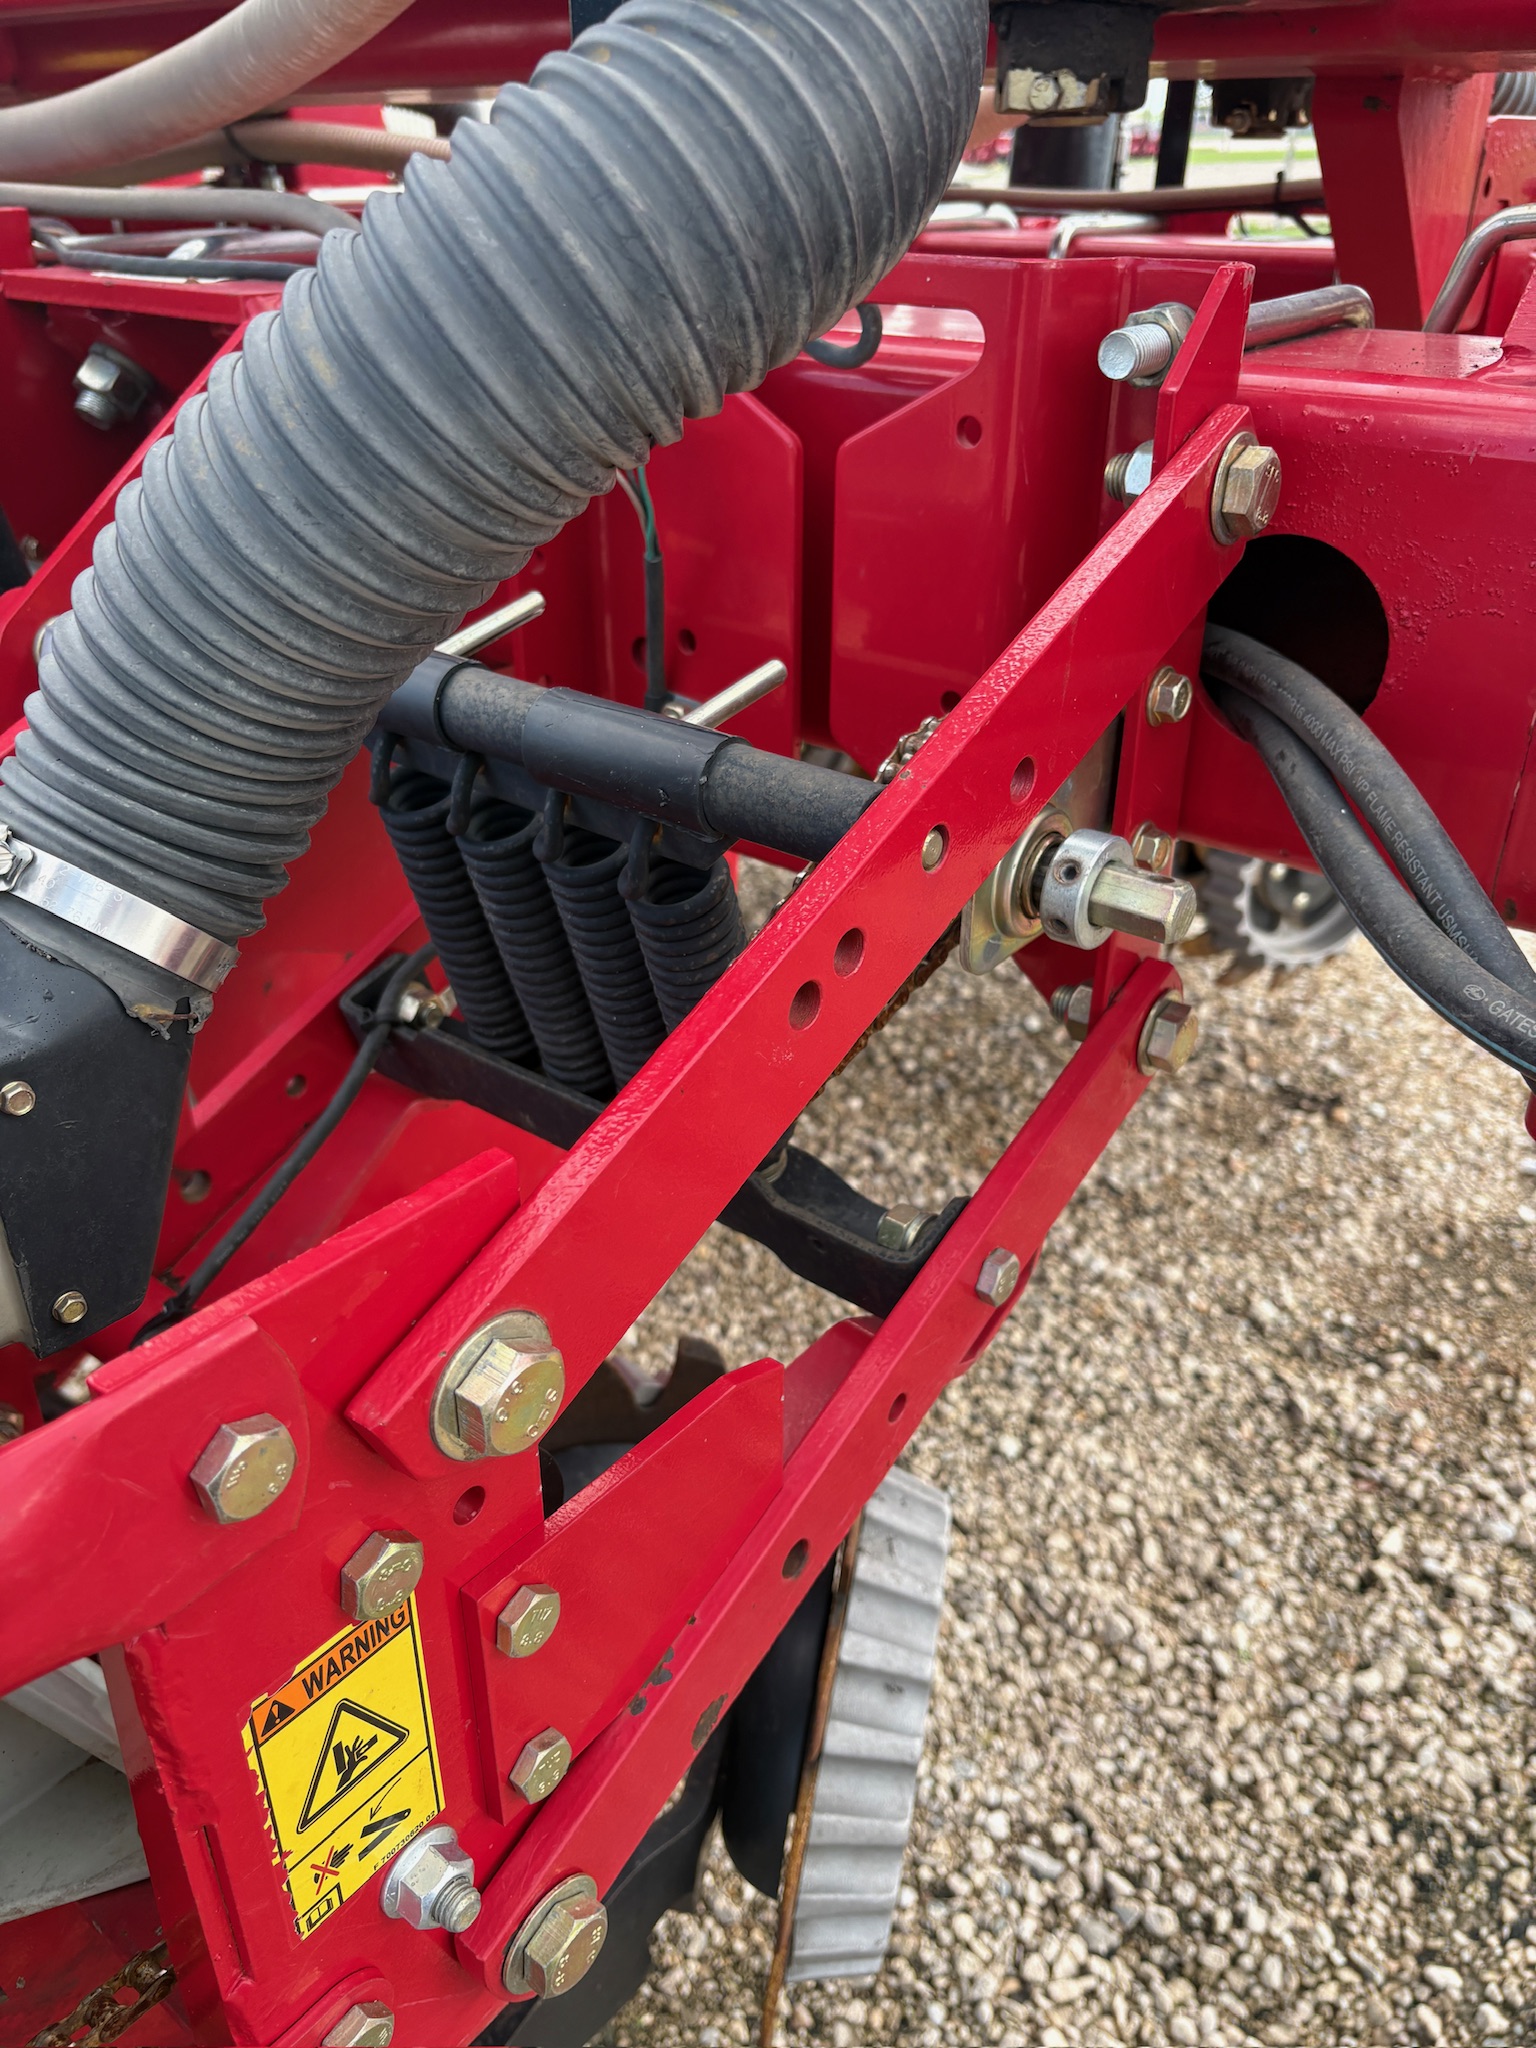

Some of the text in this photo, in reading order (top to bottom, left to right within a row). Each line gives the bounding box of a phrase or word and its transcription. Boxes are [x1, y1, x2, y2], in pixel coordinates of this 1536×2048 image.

[1303, 713, 1324, 740] 4000
[1320, 731, 1344, 761] MAX
[1338, 753, 1356, 777] PSI
[1365, 790, 1397, 838] FLAME
[1391, 830, 1443, 905] RESISTANT
[1488, 1000, 1536, 1038] GATES
[302, 1605, 406, 1700] WARNING
